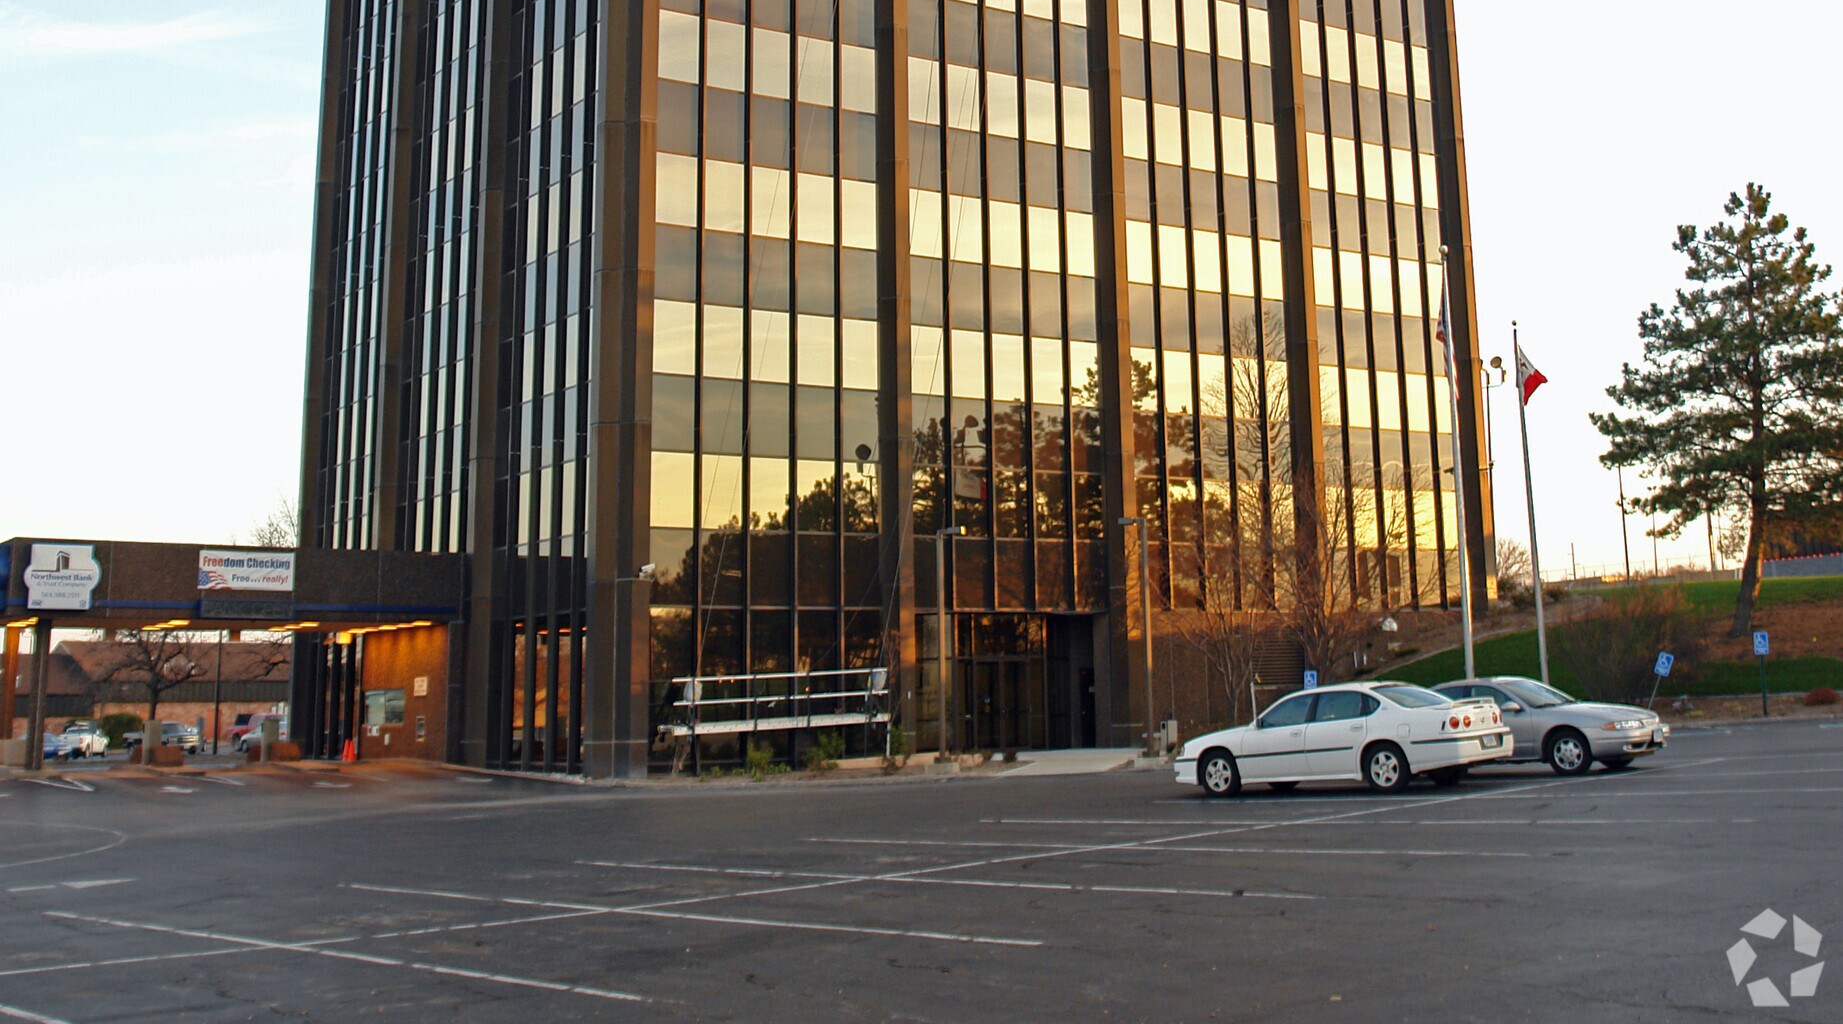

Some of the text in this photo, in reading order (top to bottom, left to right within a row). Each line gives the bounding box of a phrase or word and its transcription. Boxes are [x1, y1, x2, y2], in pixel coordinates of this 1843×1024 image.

[202, 556, 291, 570] Freedom Checking
[30, 573, 71, 581] Northwest
[262, 574, 289, 585] really!
